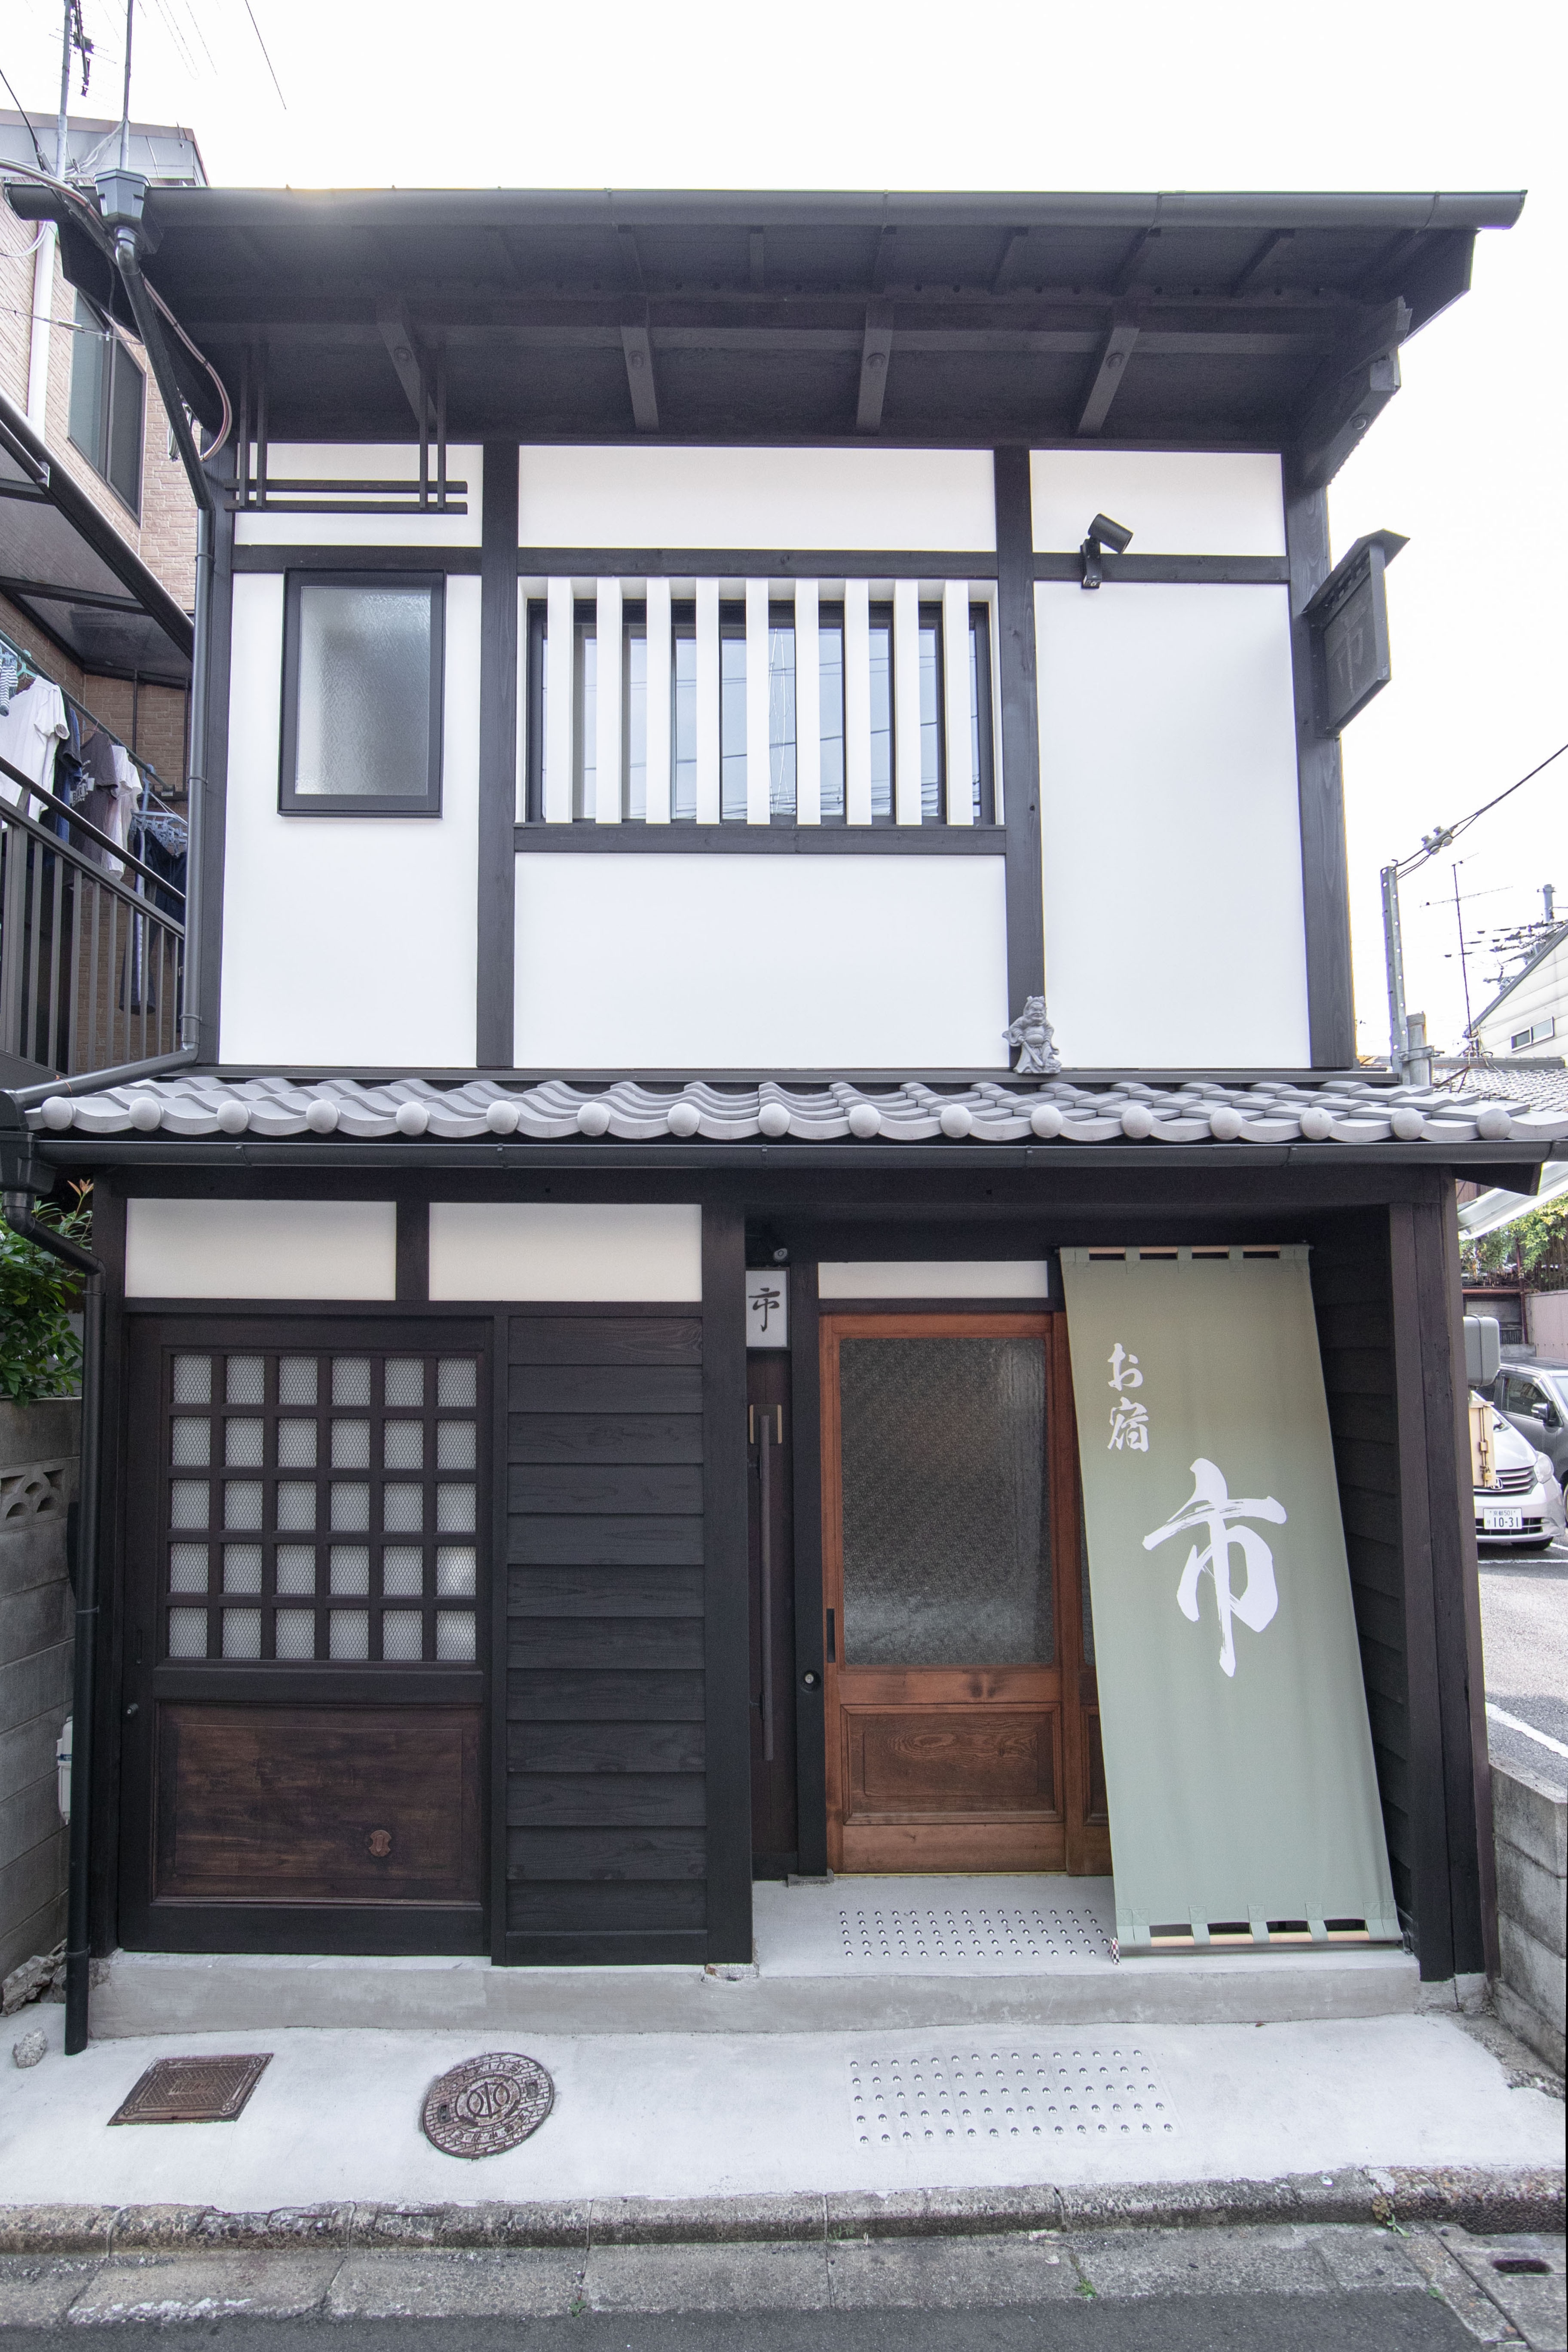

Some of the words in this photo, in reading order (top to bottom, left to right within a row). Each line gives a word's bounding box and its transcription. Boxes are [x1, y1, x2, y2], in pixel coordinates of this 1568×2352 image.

[1326, 603, 1368, 694] 市
[748, 1288, 780, 1332] 市
[1108, 1343, 1148, 1452] お宿
[1142, 1458, 1286, 1677] 市
[1494, 1517, 1518, 1527] 10-31
